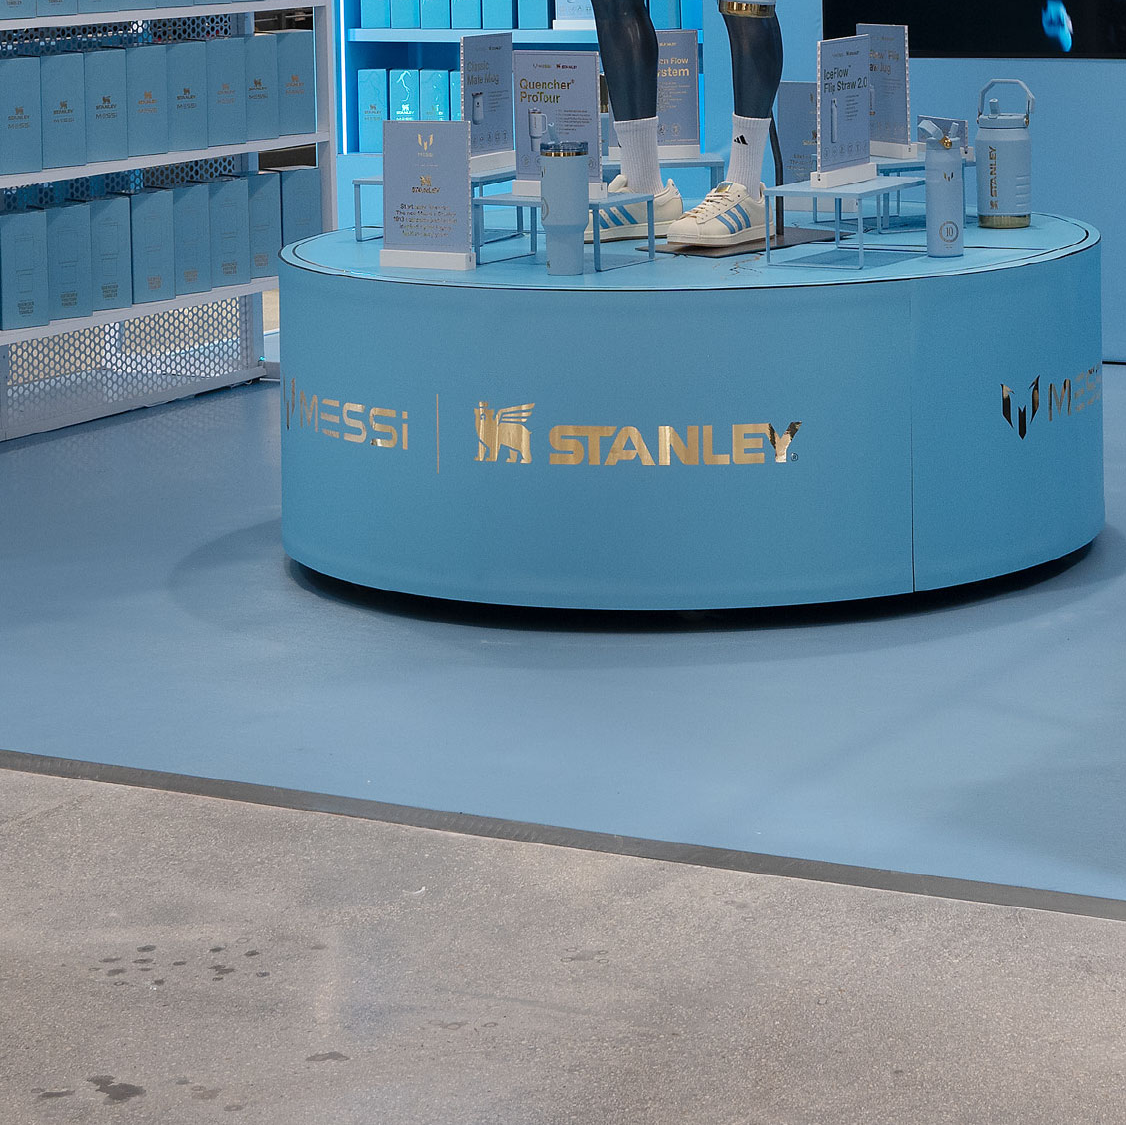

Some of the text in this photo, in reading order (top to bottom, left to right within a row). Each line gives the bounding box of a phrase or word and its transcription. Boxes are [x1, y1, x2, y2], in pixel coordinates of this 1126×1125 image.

[823, 67, 849, 81] IceFlow
[837, 80, 856, 91] Straw
[858, 77, 868, 89] 2.0
[520, 91, 560, 103] ProTour
[988, 145, 998, 197] STANLEY
[946, 227, 954, 237] 10
